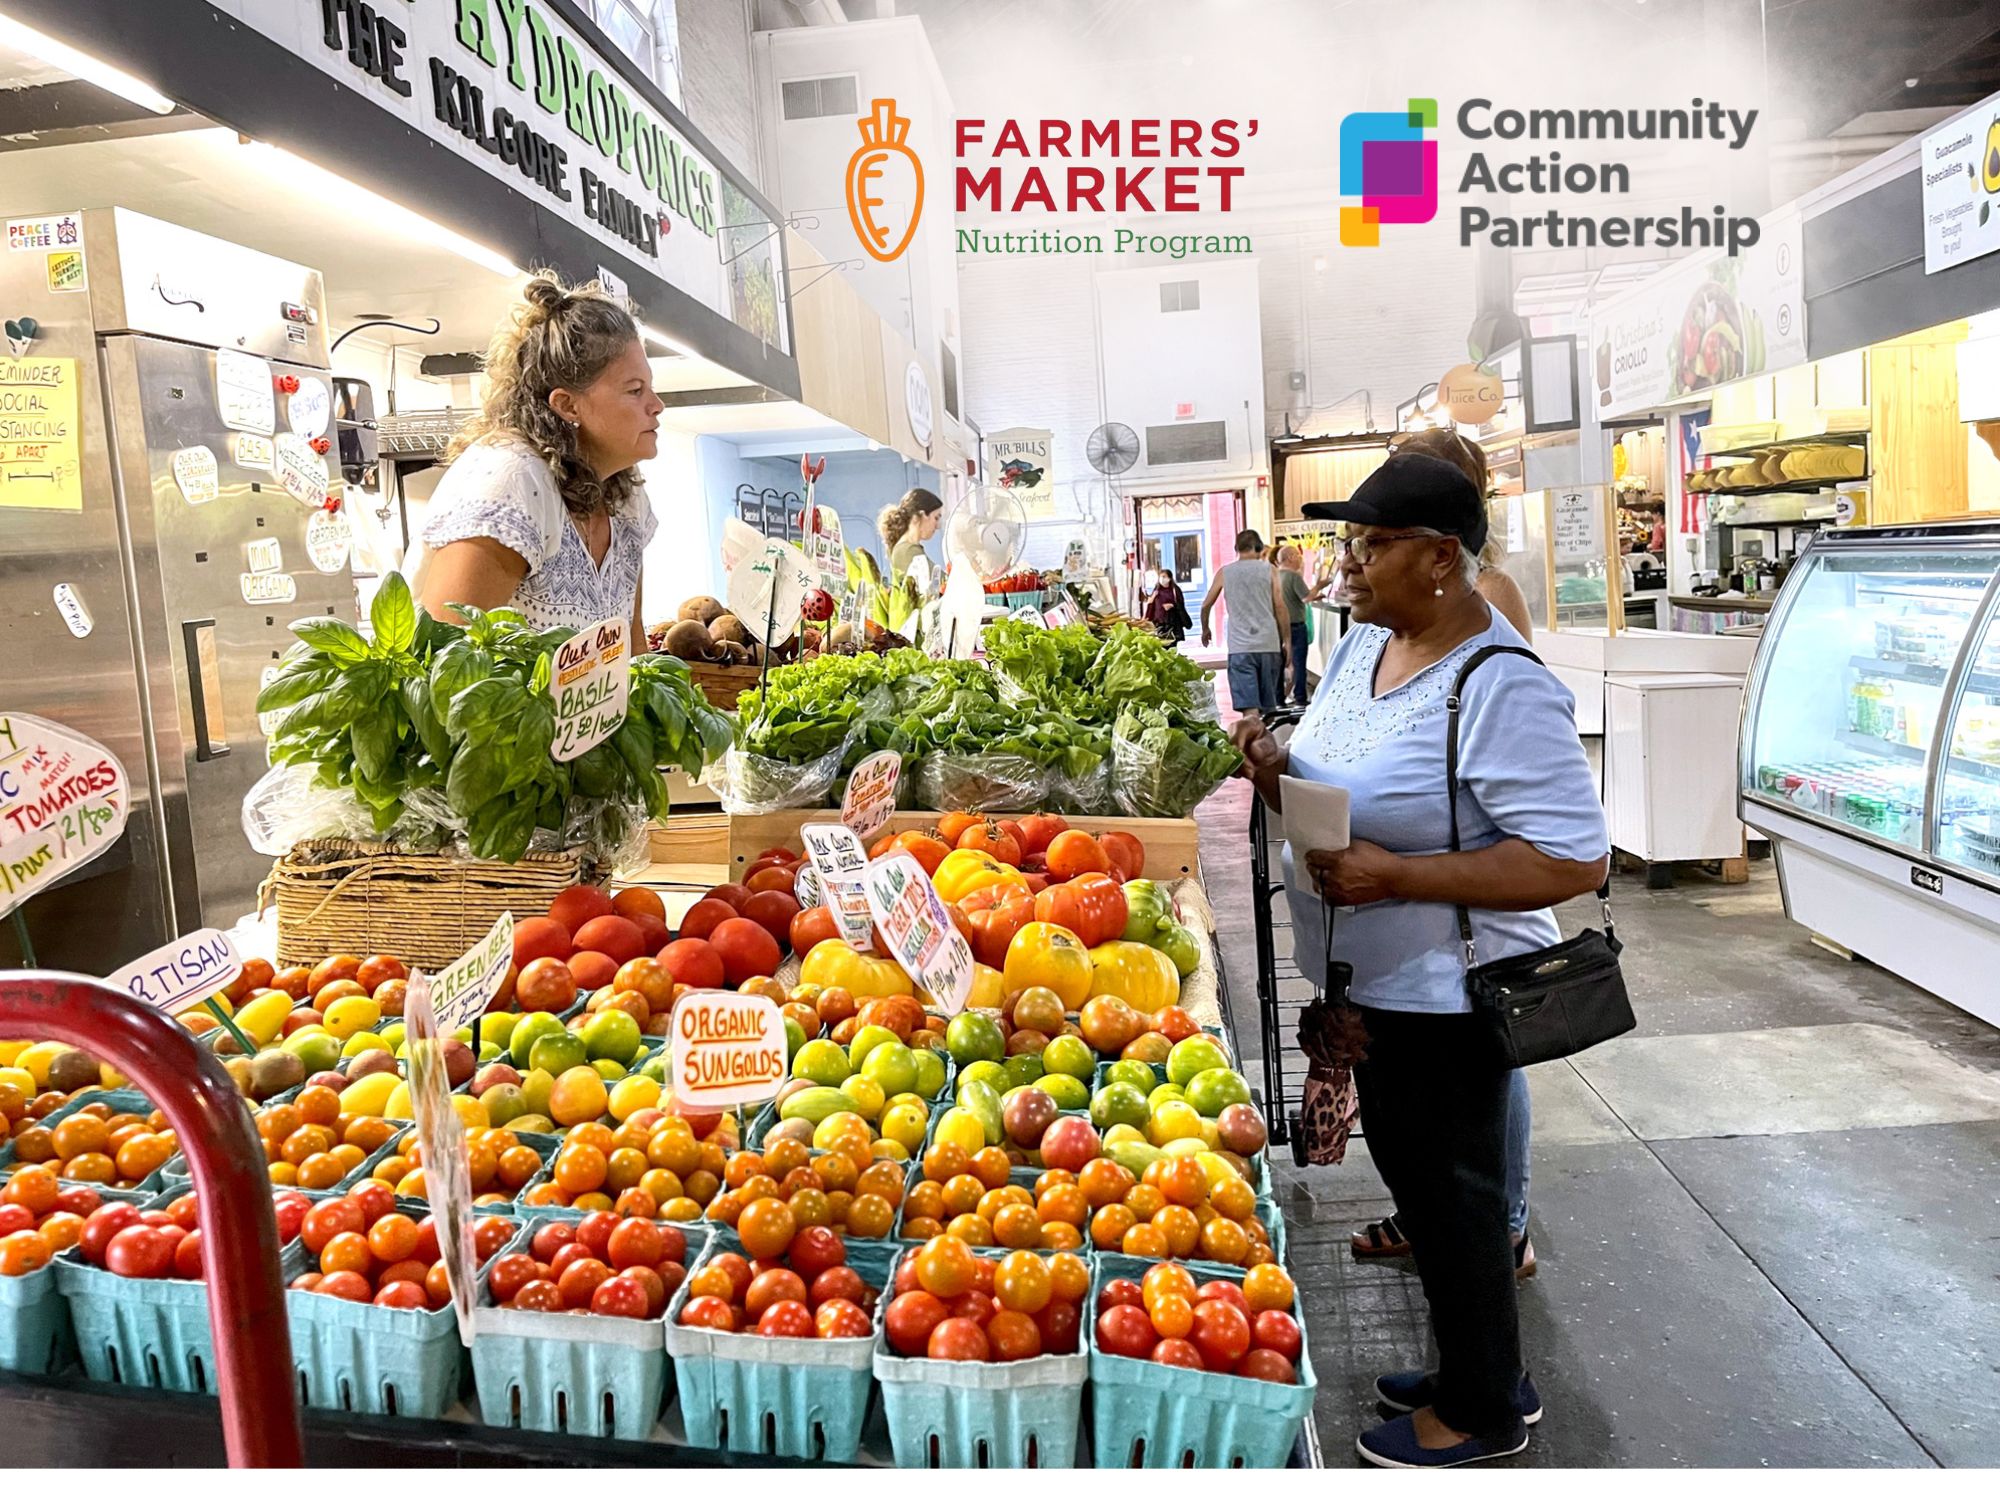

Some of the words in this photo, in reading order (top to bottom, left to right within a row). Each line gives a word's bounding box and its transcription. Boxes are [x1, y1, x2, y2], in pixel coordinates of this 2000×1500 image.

[322, 0, 412, 98] THE
[429, 57, 572, 203] KILGORE
[580, 167, 661, 259] FAMILY
[456, 0, 718, 238] HYDROPONICS
[1935, 133, 1973, 160] Guacamole
[1926, 162, 1963, 187] Specialists
[9, 223, 51, 238] PEACE
[10, 235, 52, 249] COFFEE
[1614, 346, 1648, 375] CRIOLLO
[0, 392, 49, 412] OCIAL
[1445, 385, 1476, 403] Juice
[1478, 386, 1501, 402] Co.
[16, 444, 49, 459] APART
[1012, 440, 1047, 457] BILLS
[559, 670, 619, 720] BASIL
[4, 760, 117, 835] TOMATOES
[128, 933, 230, 1002] RTISAN
[431, 950, 487, 1013] GREEN
[681, 1005, 768, 1040] ORGANIC
[683, 1048, 784, 1086] SUNGOLDS
